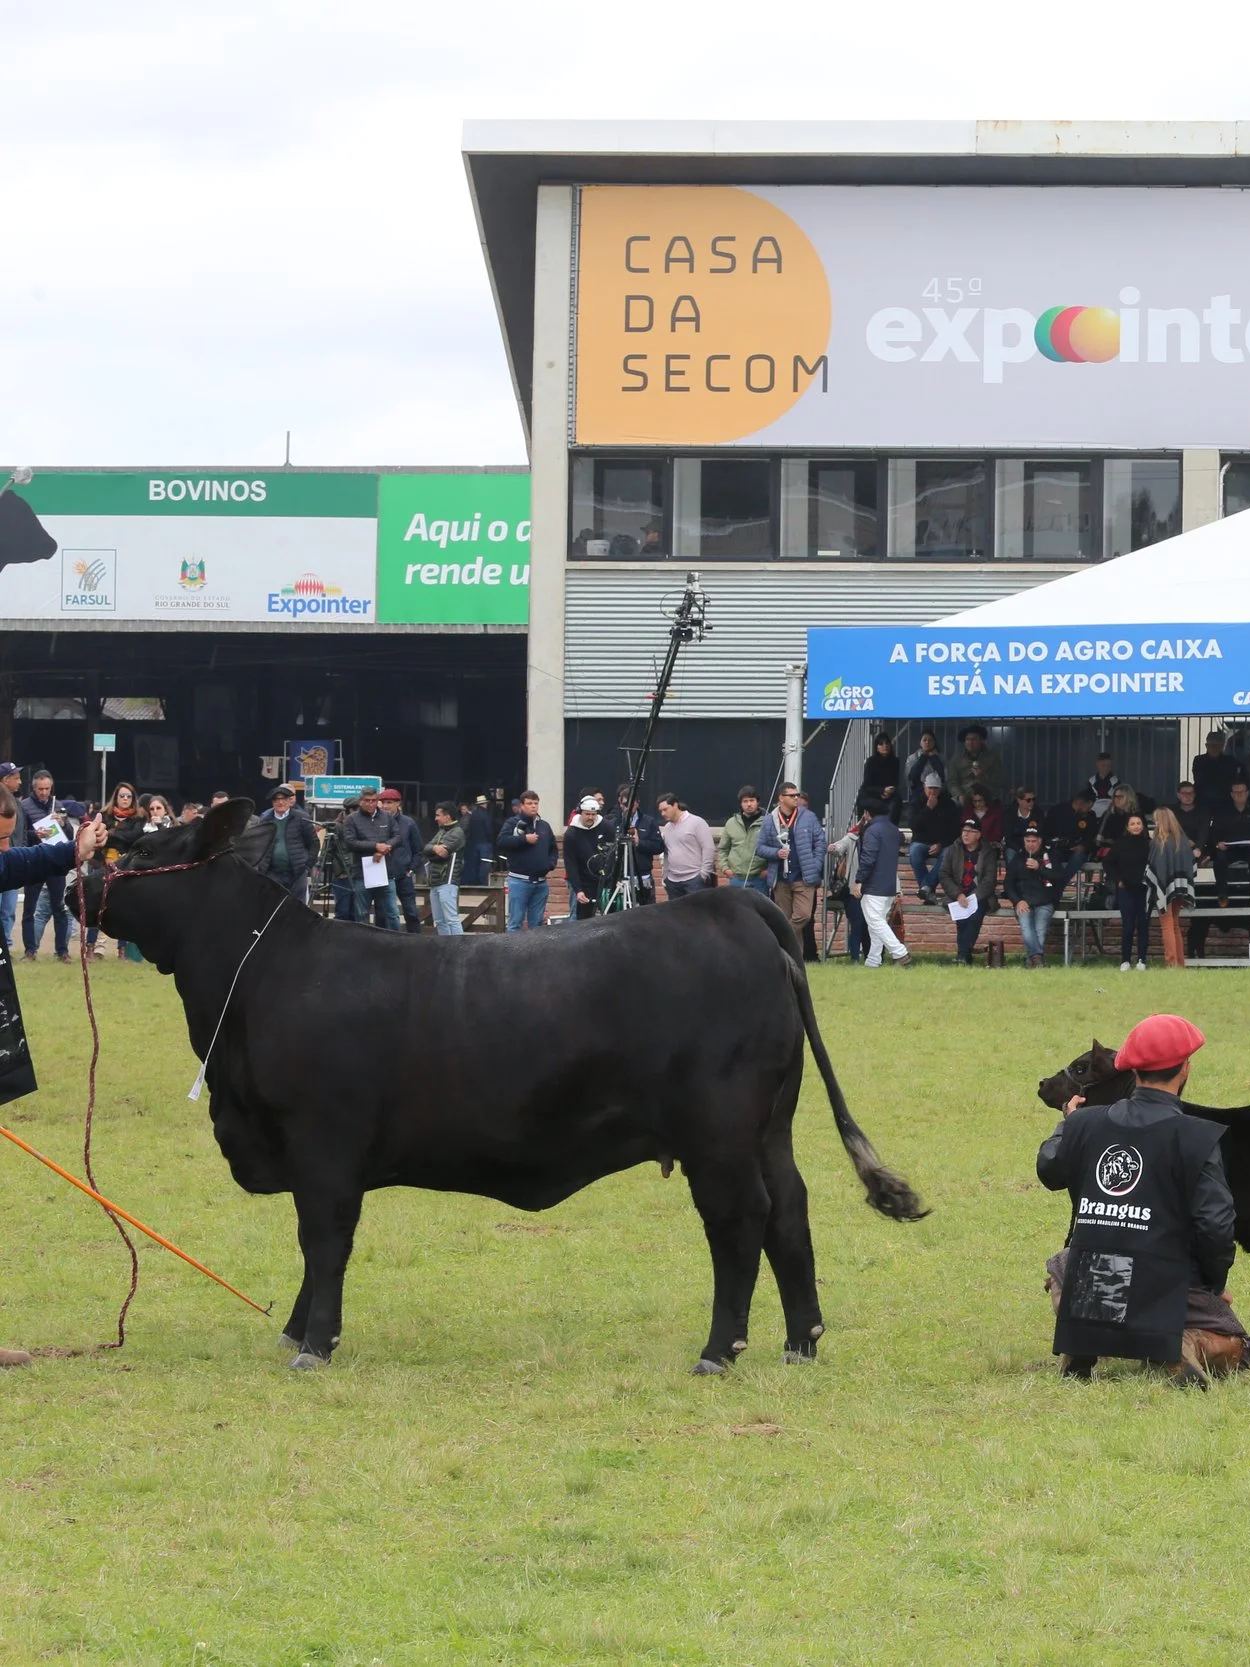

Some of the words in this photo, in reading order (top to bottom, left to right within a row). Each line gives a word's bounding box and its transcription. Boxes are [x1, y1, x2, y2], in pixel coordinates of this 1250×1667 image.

[625, 235, 783, 274] CASA
[624, 294, 701, 333] DA
[621, 353, 829, 394] SECOM
[149, 479, 267, 502] BOVINOS
[403, 512, 482, 549] Aqui
[487, 520, 509, 542] o
[404, 556, 503, 585] rende
[65, 593, 111, 606] FARSUL
[267, 593, 371, 618] Expointer
[889, 643, 909, 664] A
[915, 641, 1002, 669] FORÇA
[1008, 641, 1049, 662] DO
[1055, 639, 1134, 662] AGRO
[1140, 638, 1223, 660] CAIXA
[830, 685, 874, 699] AGRO
[928, 668, 987, 696] ESTÁ
[994, 673, 1034, 695] NA
[1041, 672, 1185, 694] EXPOINTER
[824, 698, 875, 712] CAIXA
[1079, 1197, 1151, 1221] Brangus
